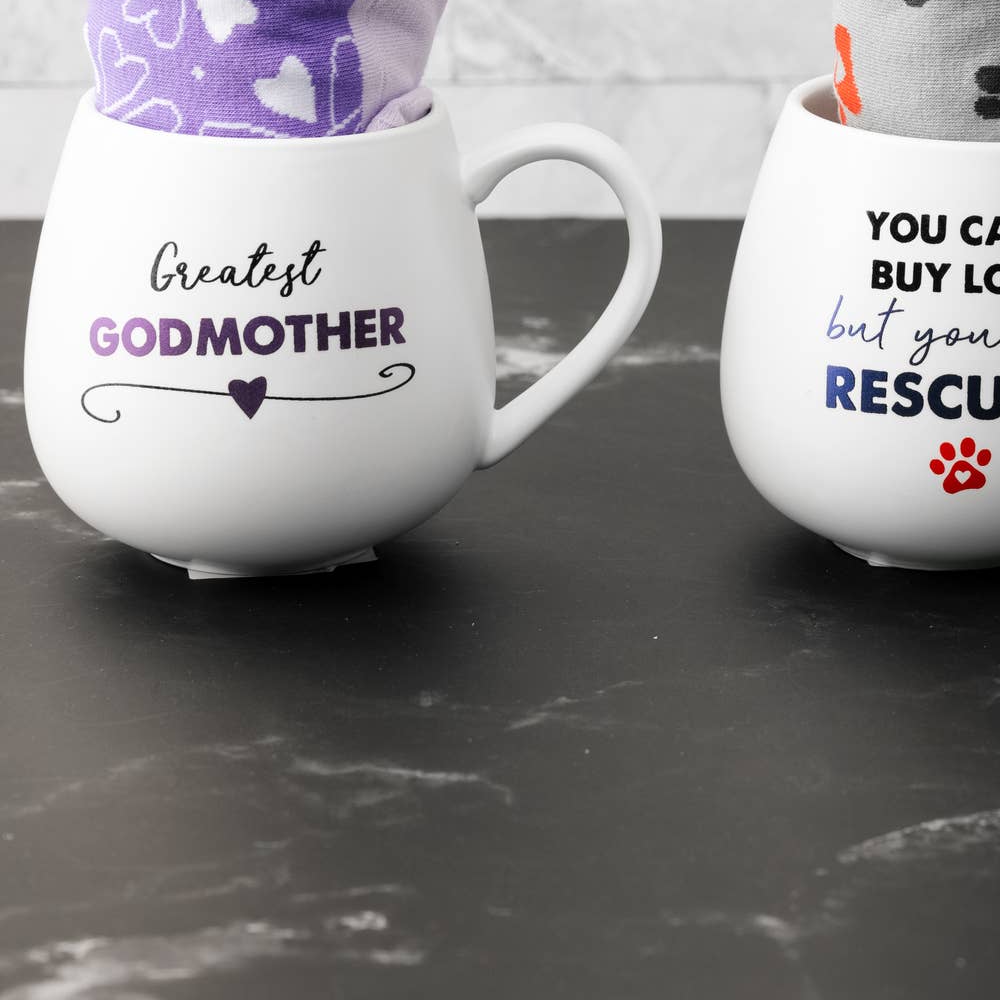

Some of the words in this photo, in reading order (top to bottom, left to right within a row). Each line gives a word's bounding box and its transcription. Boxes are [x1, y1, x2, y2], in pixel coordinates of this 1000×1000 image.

[867, 211, 947, 244] YOU
[150, 239, 327, 298] Greatest
[871, 260, 951, 293] BUY
[89, 306, 407, 357] GODMOTHER
[826, 295, 905, 350] but
